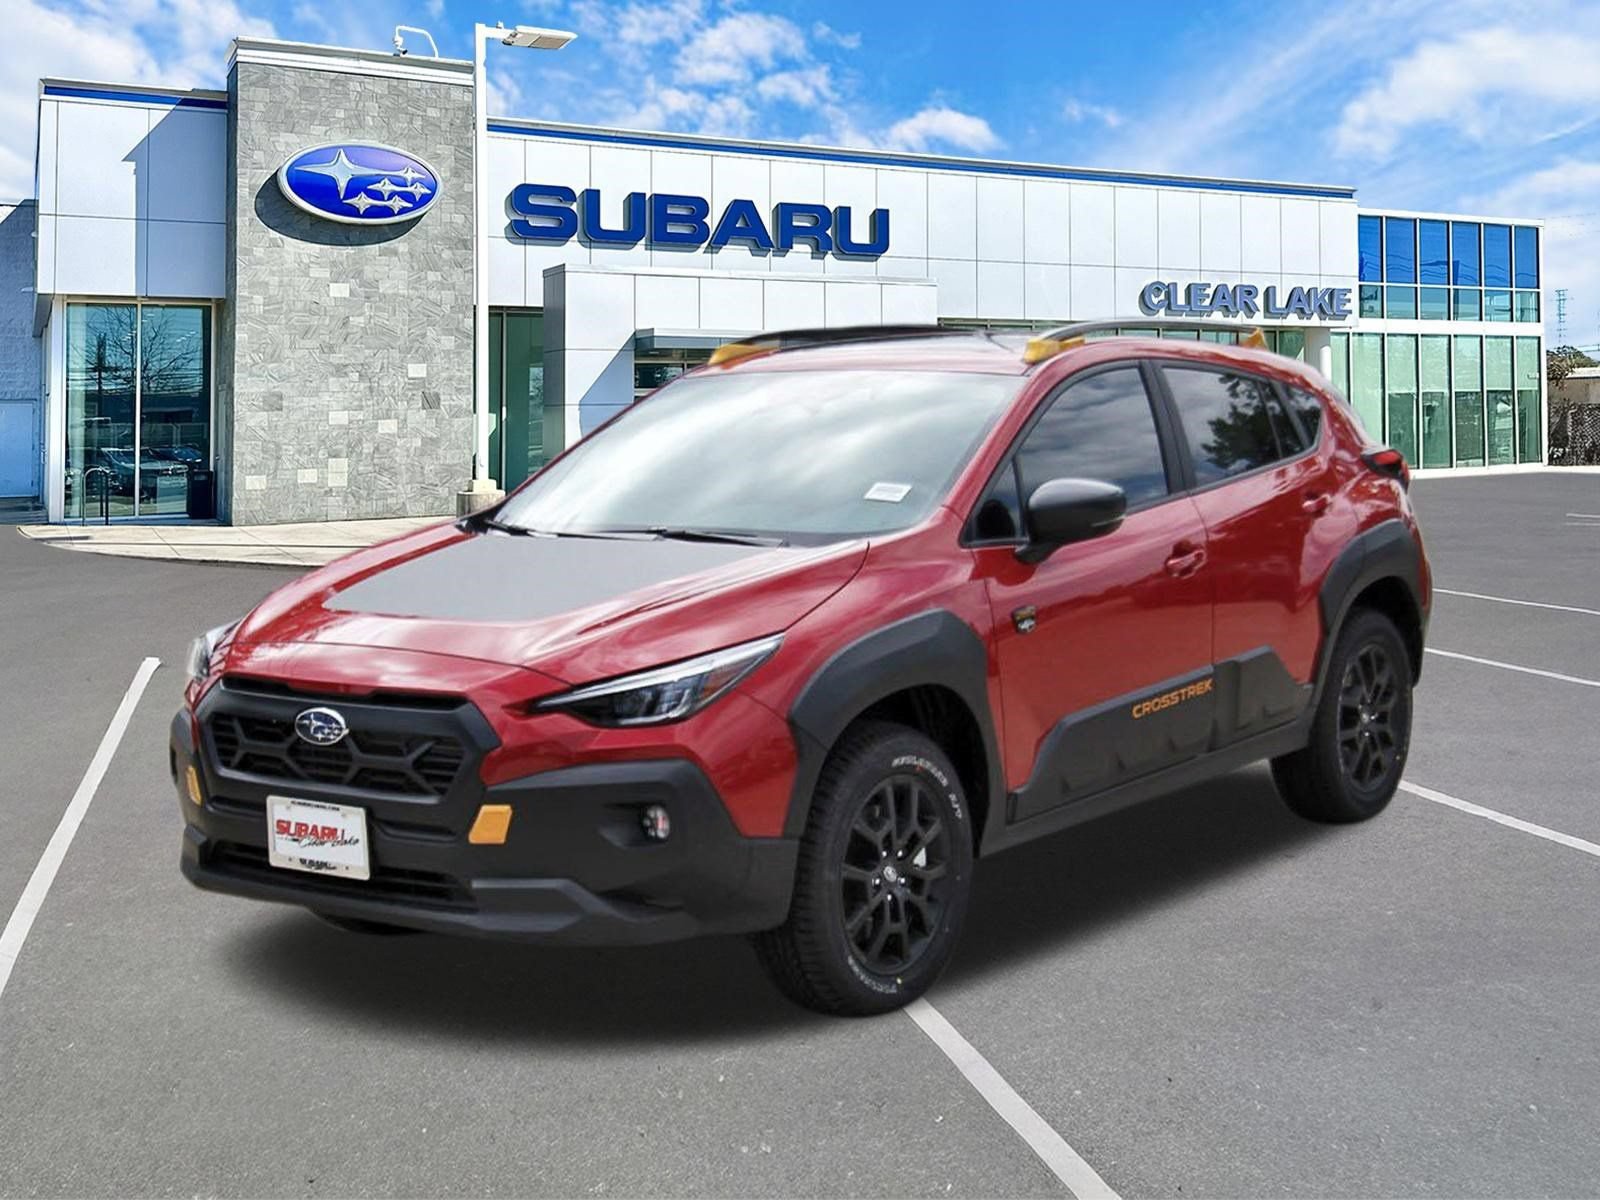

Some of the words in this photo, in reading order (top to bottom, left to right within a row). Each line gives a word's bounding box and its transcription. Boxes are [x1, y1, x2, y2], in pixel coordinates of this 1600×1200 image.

[506, 183, 890, 259] SUBARU
[1140, 281, 1259, 317] CLEAR
[1264, 286, 1352, 319] LAKE
[1131, 677, 1212, 719] CROSSTREK
[276, 819, 344, 841] SUBARU
